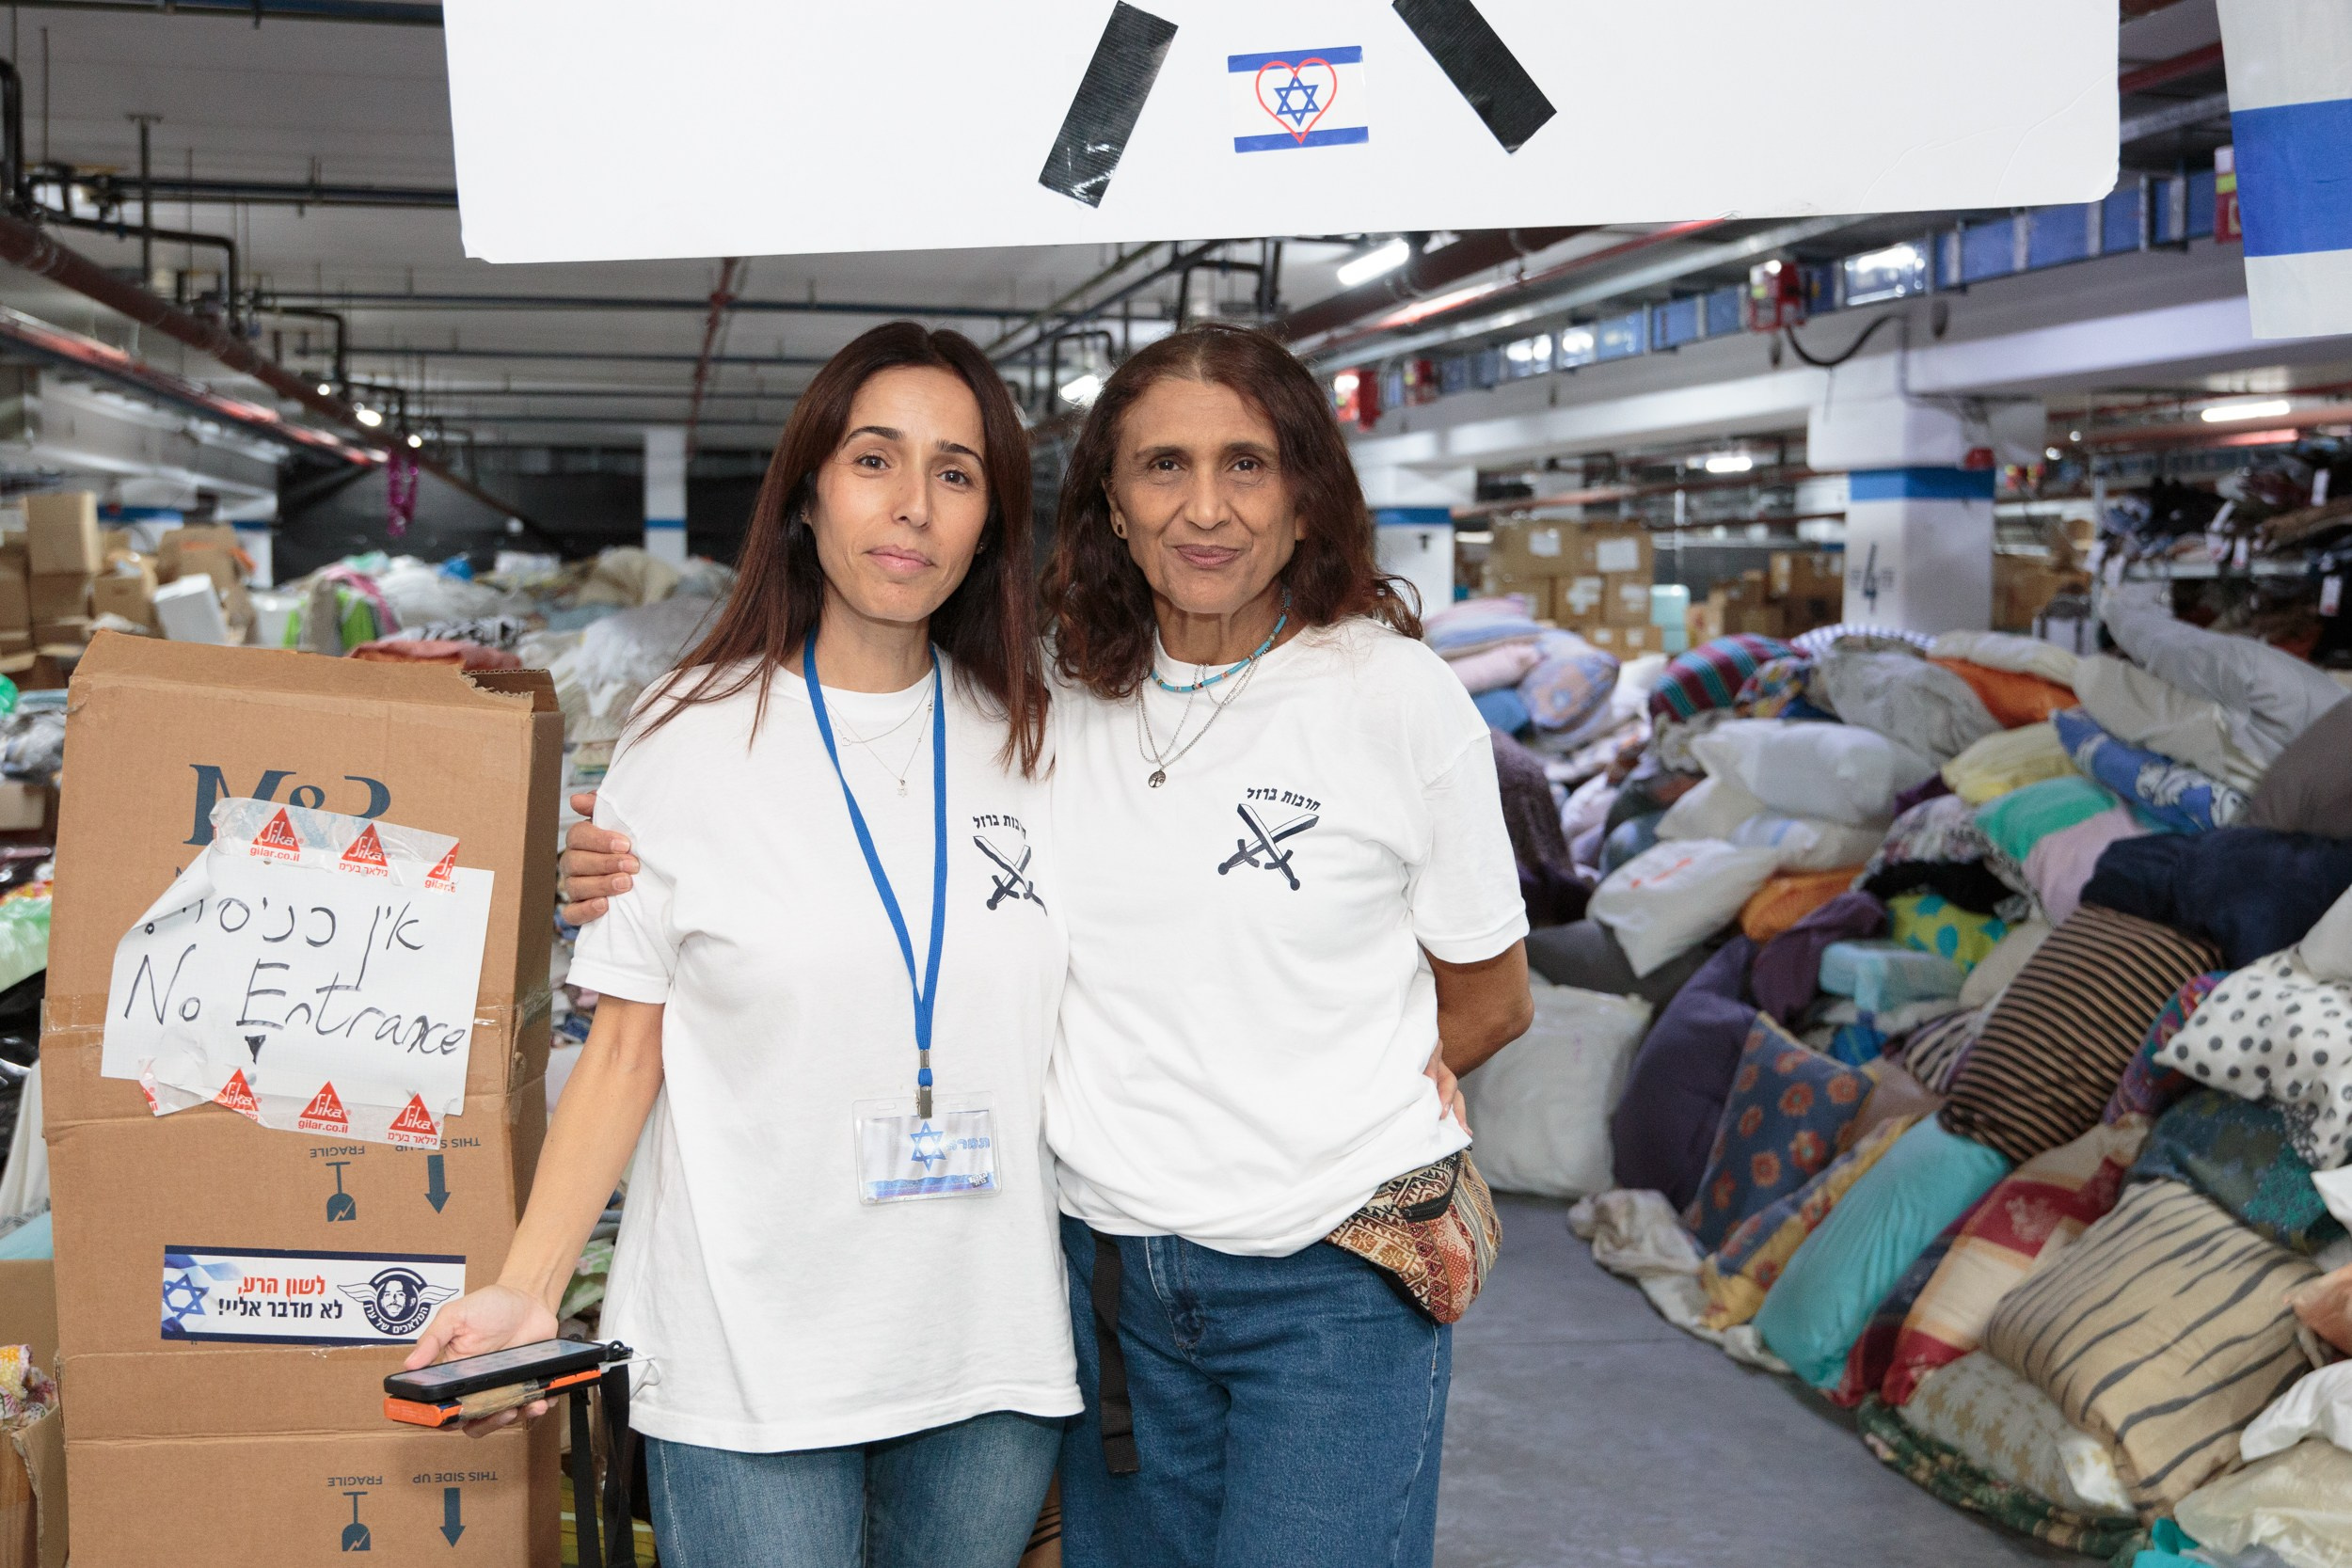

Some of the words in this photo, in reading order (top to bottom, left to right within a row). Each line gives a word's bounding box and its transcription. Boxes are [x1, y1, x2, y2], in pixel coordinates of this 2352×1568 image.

[1247, 787, 1279, 801] ברזל
[1280, 790, 1322, 812] חרבות
[972, 814, 1000, 830] ברזל
[1003, 815, 1026, 840] רבות
[259, 820, 295, 847] Sika
[249, 847, 301, 863] gilar.co.il
[348, 835, 383, 863] Sika
[364, 864, 389, 878] גילאר
[355, 900, 424, 990] אין
[123, 943, 201, 1026] No
[235, 958, 468, 1057] Entrance
[217, 1082, 253, 1106] Sika
[307, 1093, 342, 1118] Sika
[397, 1104, 431, 1131] Sika
[297, 1118, 348, 1134] gilar.co.il
[413, 1133, 437, 1147] גילאר
[451, 1137, 482, 1148] THIS
[310, 1145, 365, 1158] FRAGILE
[286, 1274, 326, 1298] לשון
[218, 1296, 262, 1317] אליי!
[267, 1301, 313, 1318] מדבר
[320, 1298, 343, 1319] לא
[363, 1304, 377, 1320] ערן
[376, 1318, 390, 1331] של
[392, 1307, 429, 1334] המלאכים
[326, 1476, 383, 1487] FRAGILE
[412, 1473, 431, 1484] UP
[435, 1472, 465, 1483] SIDE
[469, 1471, 499, 1481] THIS
